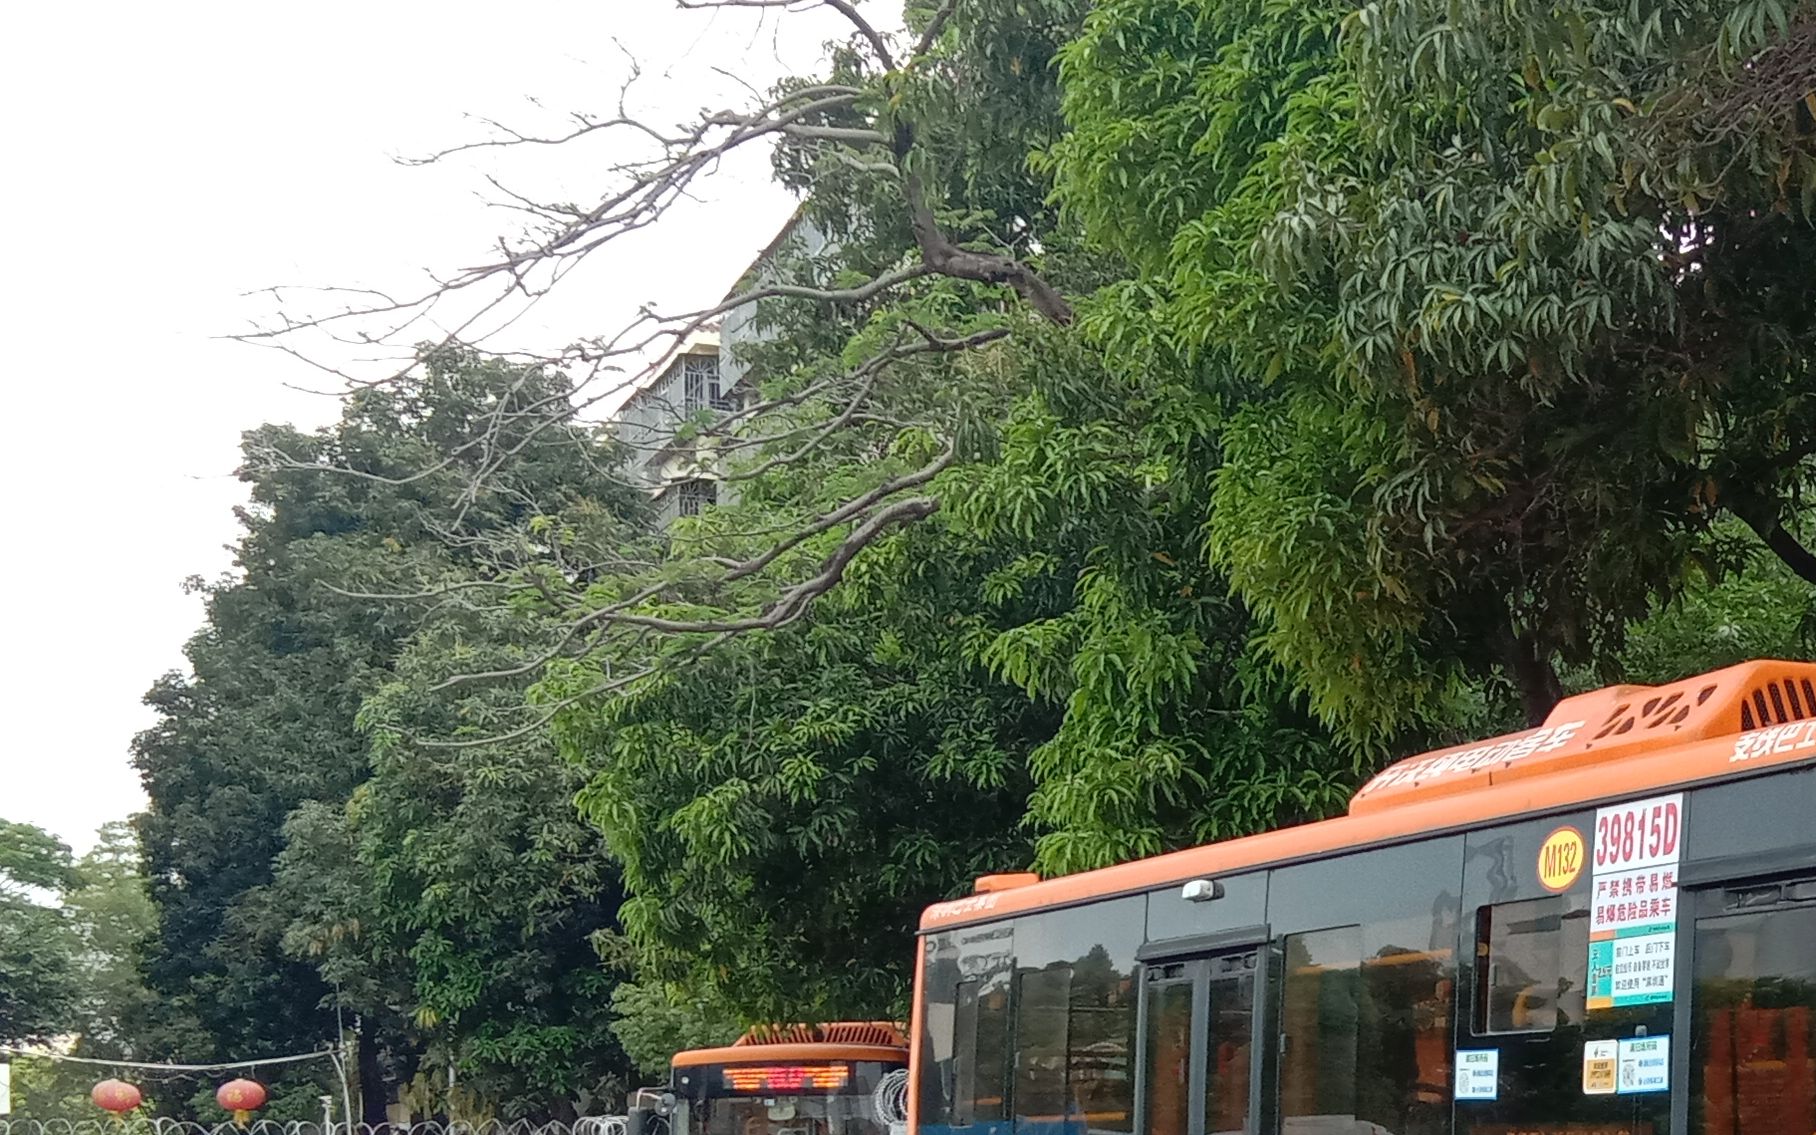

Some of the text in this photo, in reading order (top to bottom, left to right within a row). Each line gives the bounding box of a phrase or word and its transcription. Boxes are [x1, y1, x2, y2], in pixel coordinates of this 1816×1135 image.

[1596, 802, 1678, 868] 39815D
[1544, 841, 1577, 879] M132
[1597, 871, 1672, 900] 严禁携带易燃
[1595, 897, 1671, 925] 易爆危险品乘车
